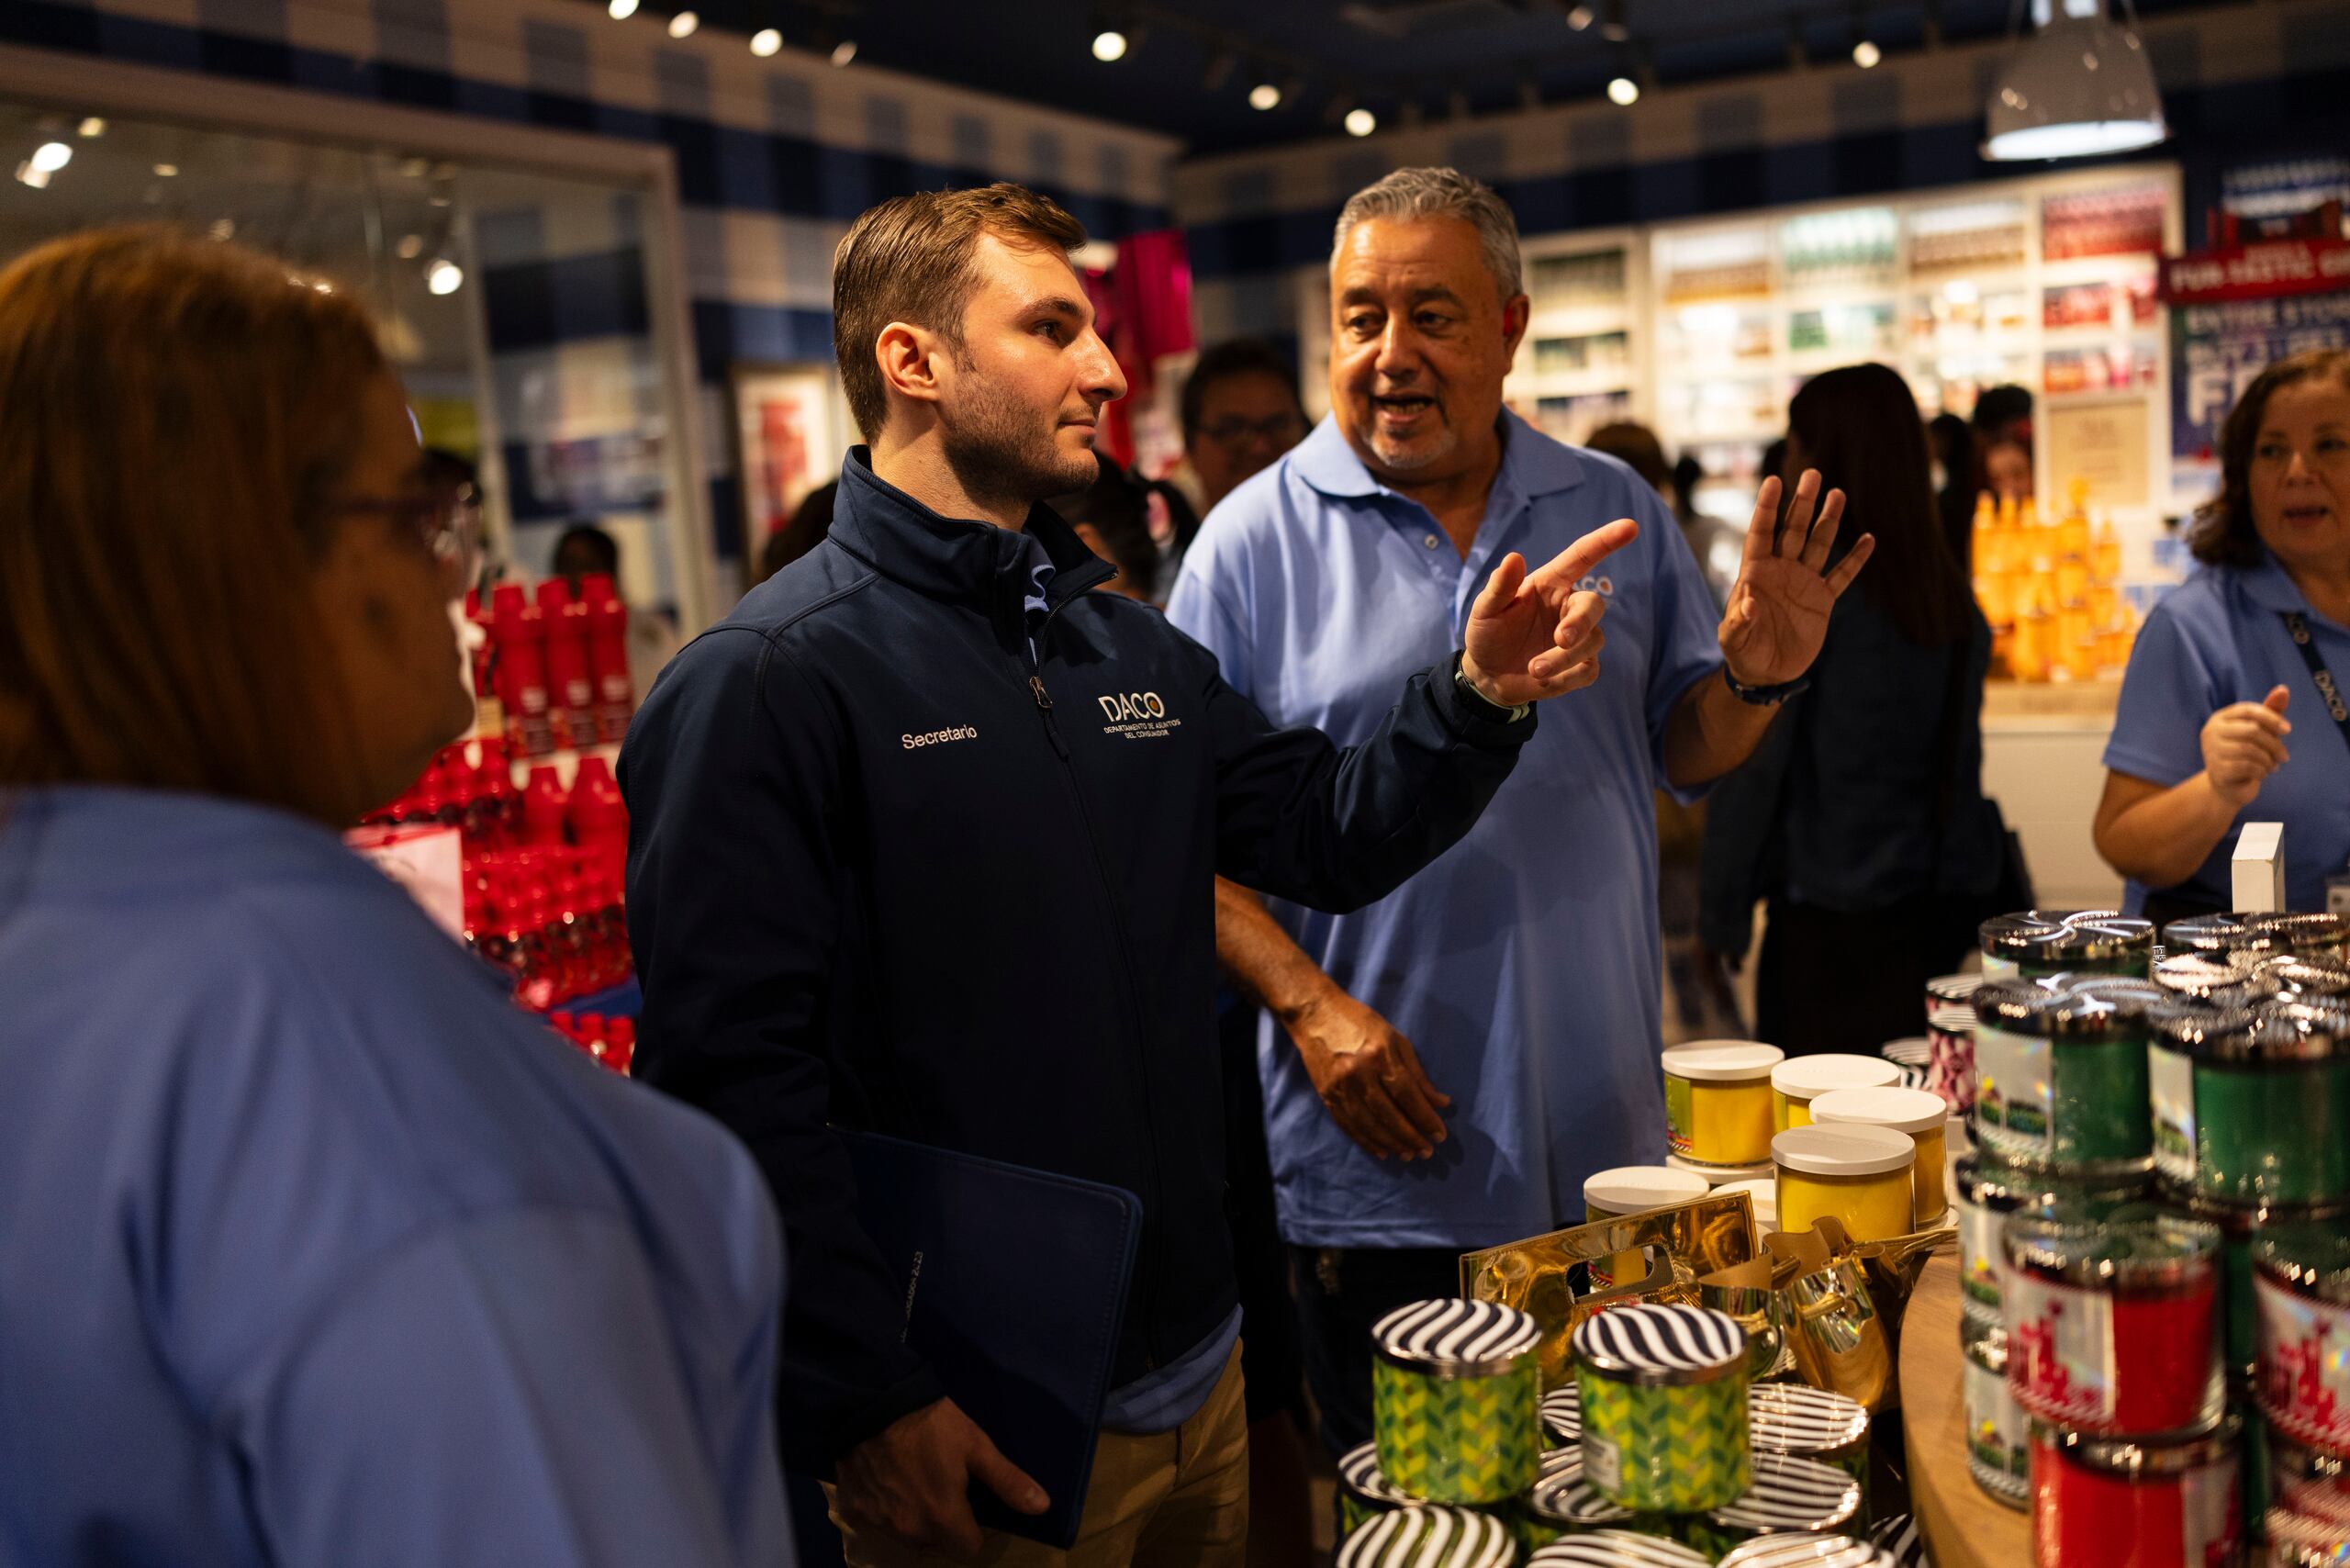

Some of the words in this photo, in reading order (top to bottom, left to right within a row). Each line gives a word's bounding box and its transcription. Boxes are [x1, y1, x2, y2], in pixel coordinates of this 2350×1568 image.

[1572, 576, 1613, 596] CO
[1098, 692, 1165, 722] DACO
[2314, 669, 2347, 722] DACO
[901, 724, 978, 749] Secretario
[1103, 722, 1147, 734] DEPARTAMENTO
[1156, 718, 1181, 730] ASUNTOS
